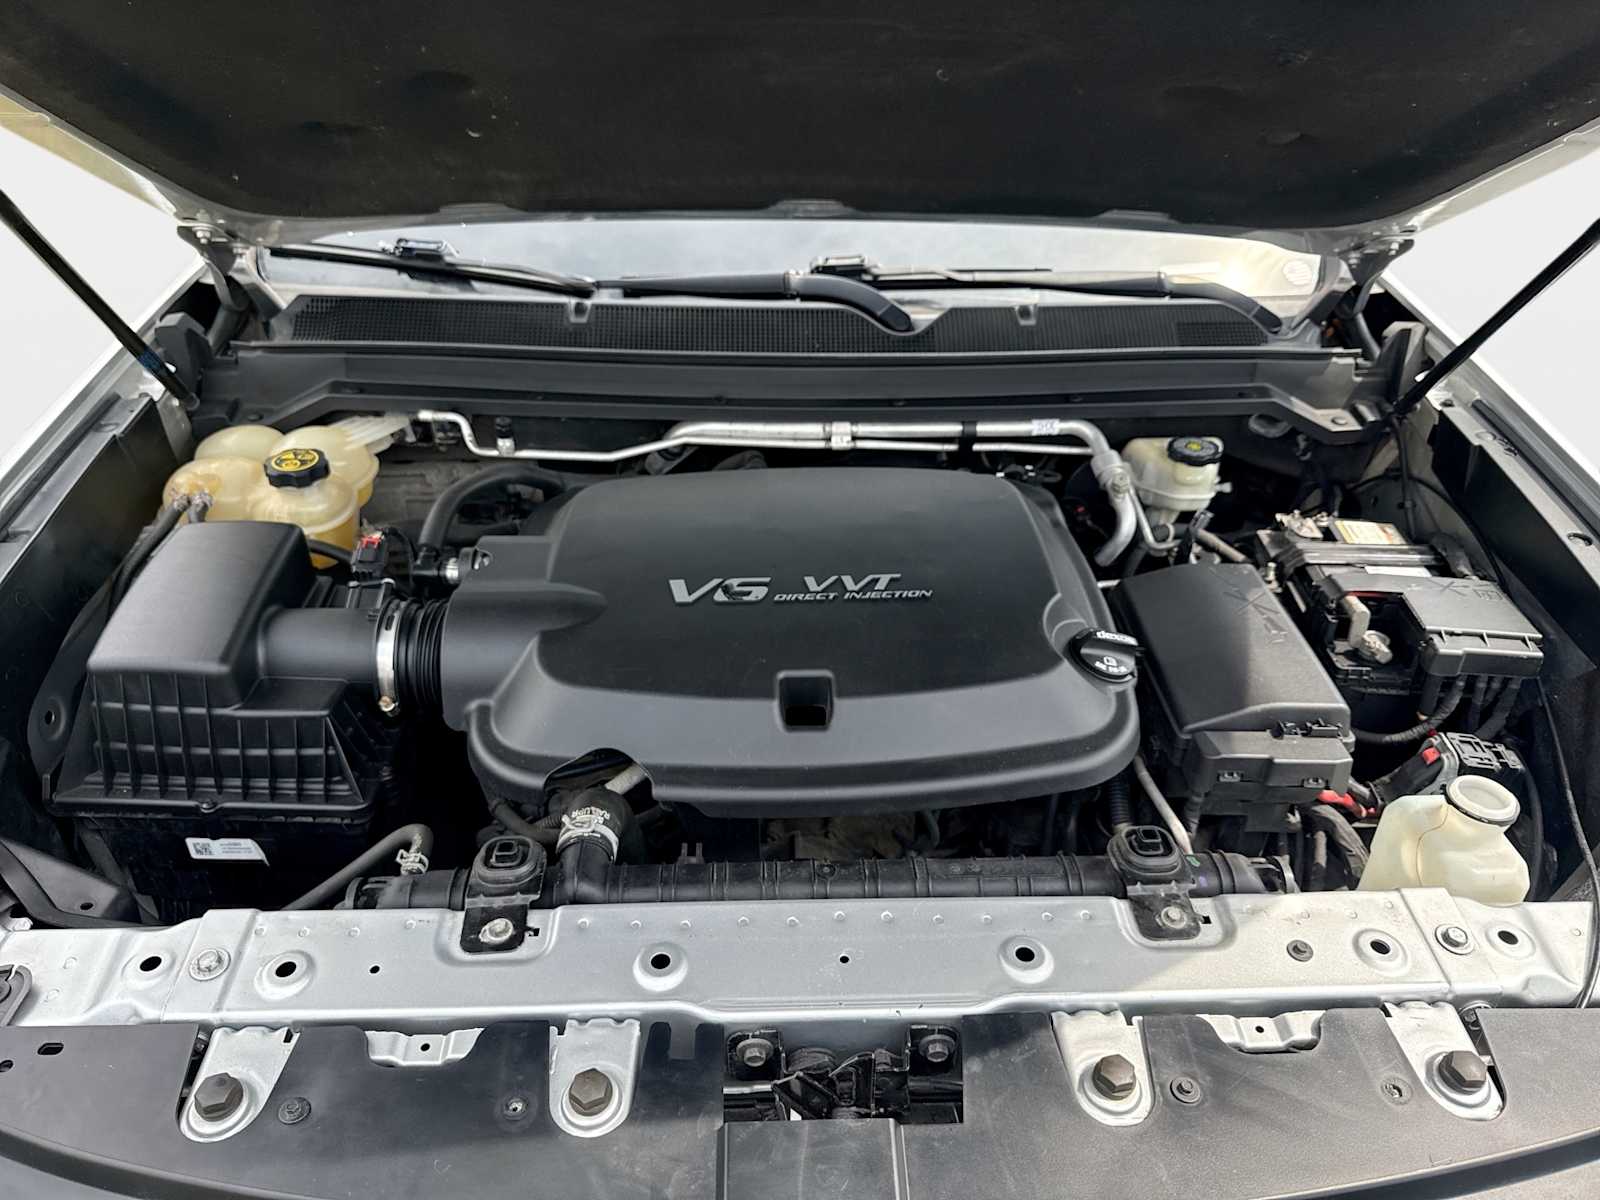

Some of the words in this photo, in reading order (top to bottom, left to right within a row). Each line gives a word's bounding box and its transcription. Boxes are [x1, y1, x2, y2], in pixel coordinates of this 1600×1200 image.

[668, 577, 772, 603] V6
[803, 573, 902, 592] VVT
[773, 592, 839, 601] DIRECT
[843, 589, 933, 600] INJECTION
